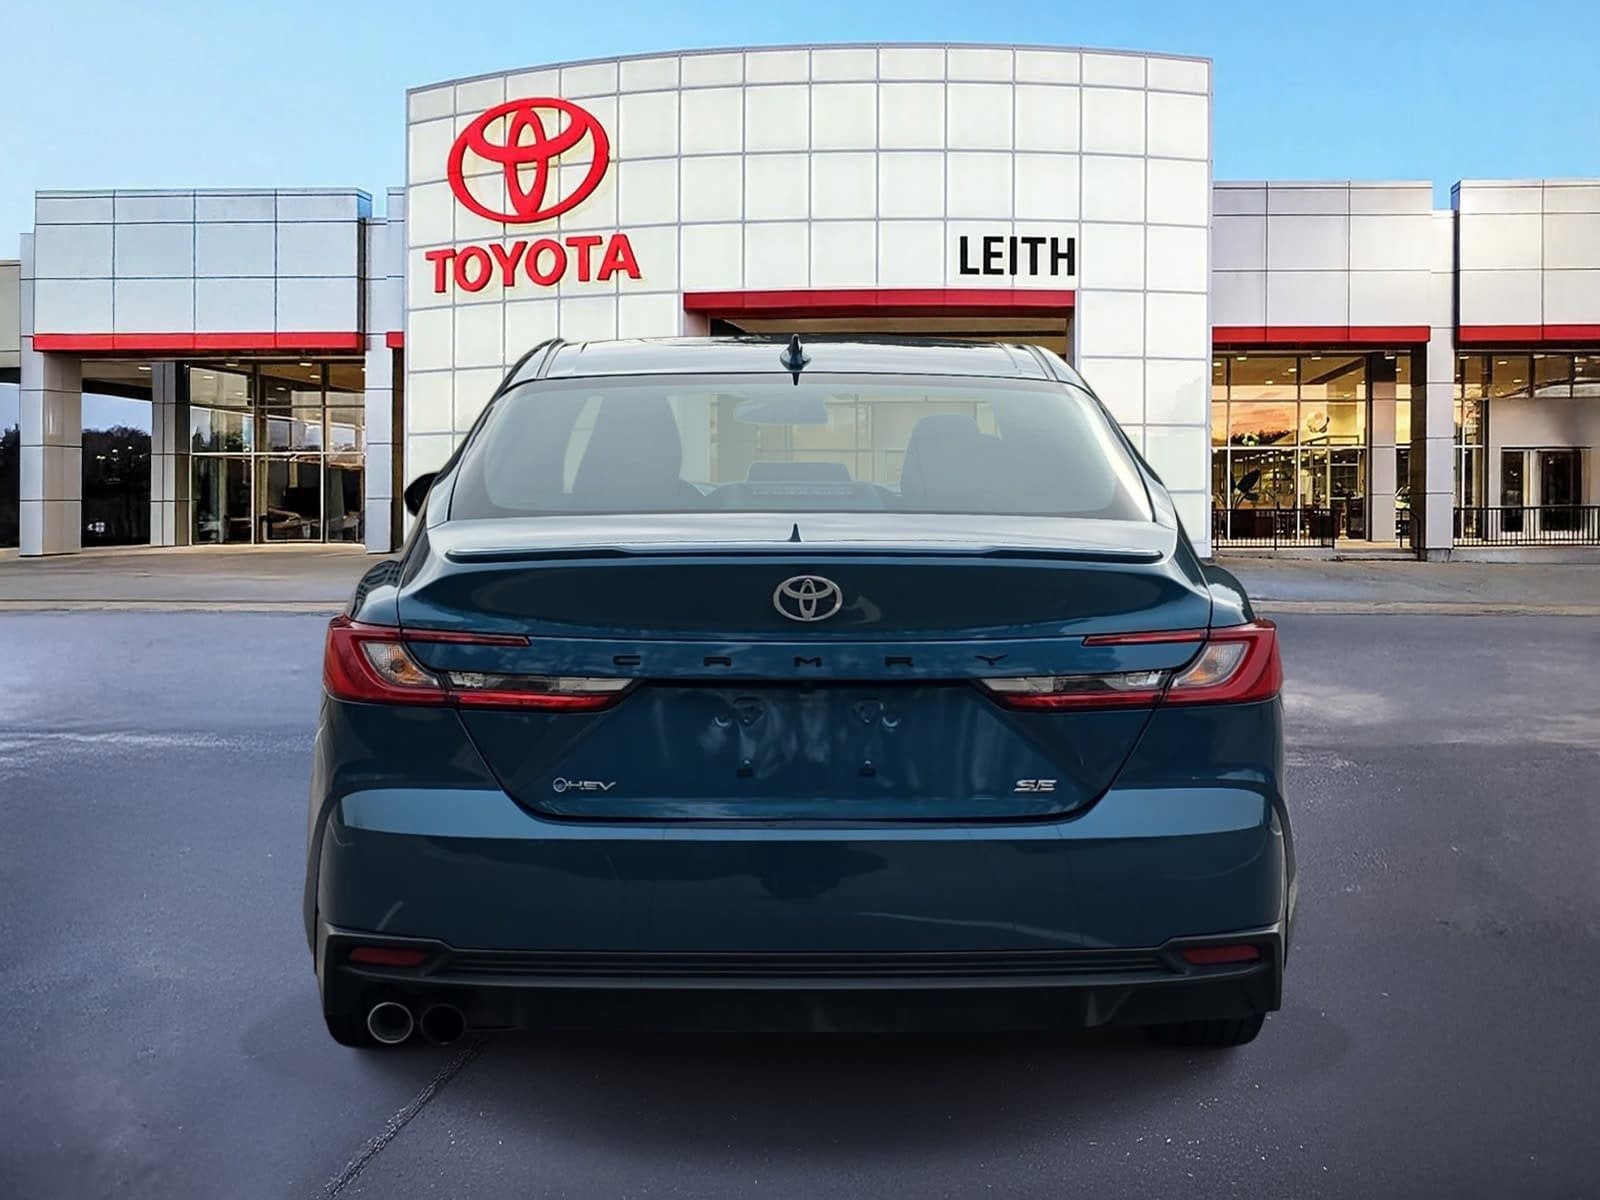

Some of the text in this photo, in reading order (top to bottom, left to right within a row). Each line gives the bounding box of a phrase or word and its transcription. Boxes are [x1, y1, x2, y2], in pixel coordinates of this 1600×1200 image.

[959, 235, 1076, 276] LEITH
[425, 234, 641, 293] TOYOTA
[612, 653, 1009, 668] CAMRY
[567, 780, 617, 791] HEV
[1013, 779, 1057, 792] SE
